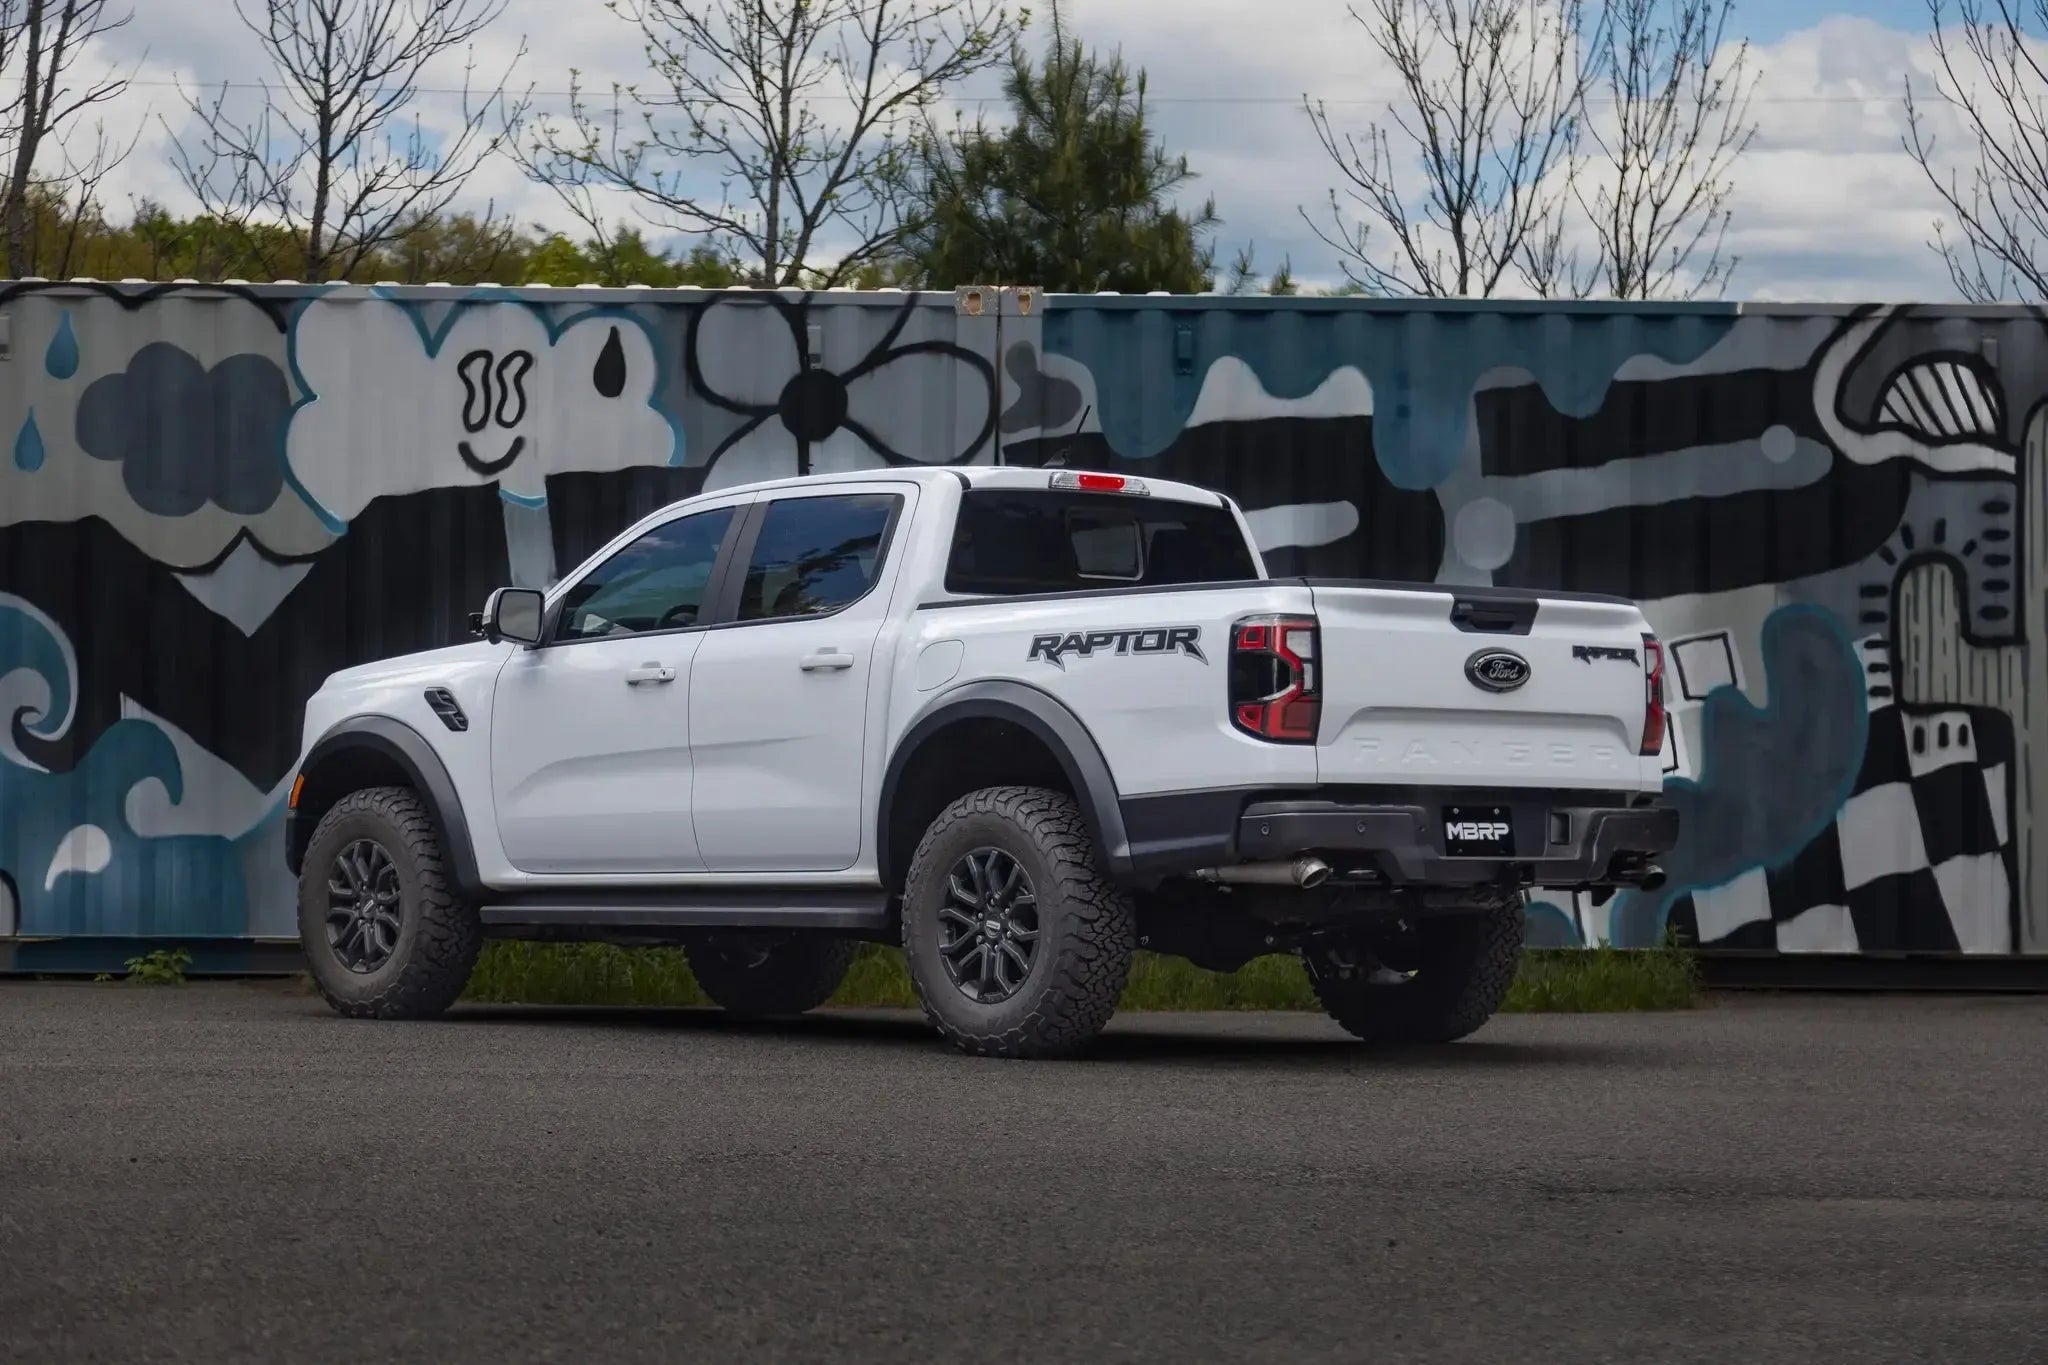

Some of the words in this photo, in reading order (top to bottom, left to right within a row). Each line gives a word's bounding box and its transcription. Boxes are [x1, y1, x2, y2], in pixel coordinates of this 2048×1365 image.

[1027, 625, 1208, 672] RAPTOR
[1489, 660, 1519, 679] Ford
[1446, 822, 1509, 840] MBRP
